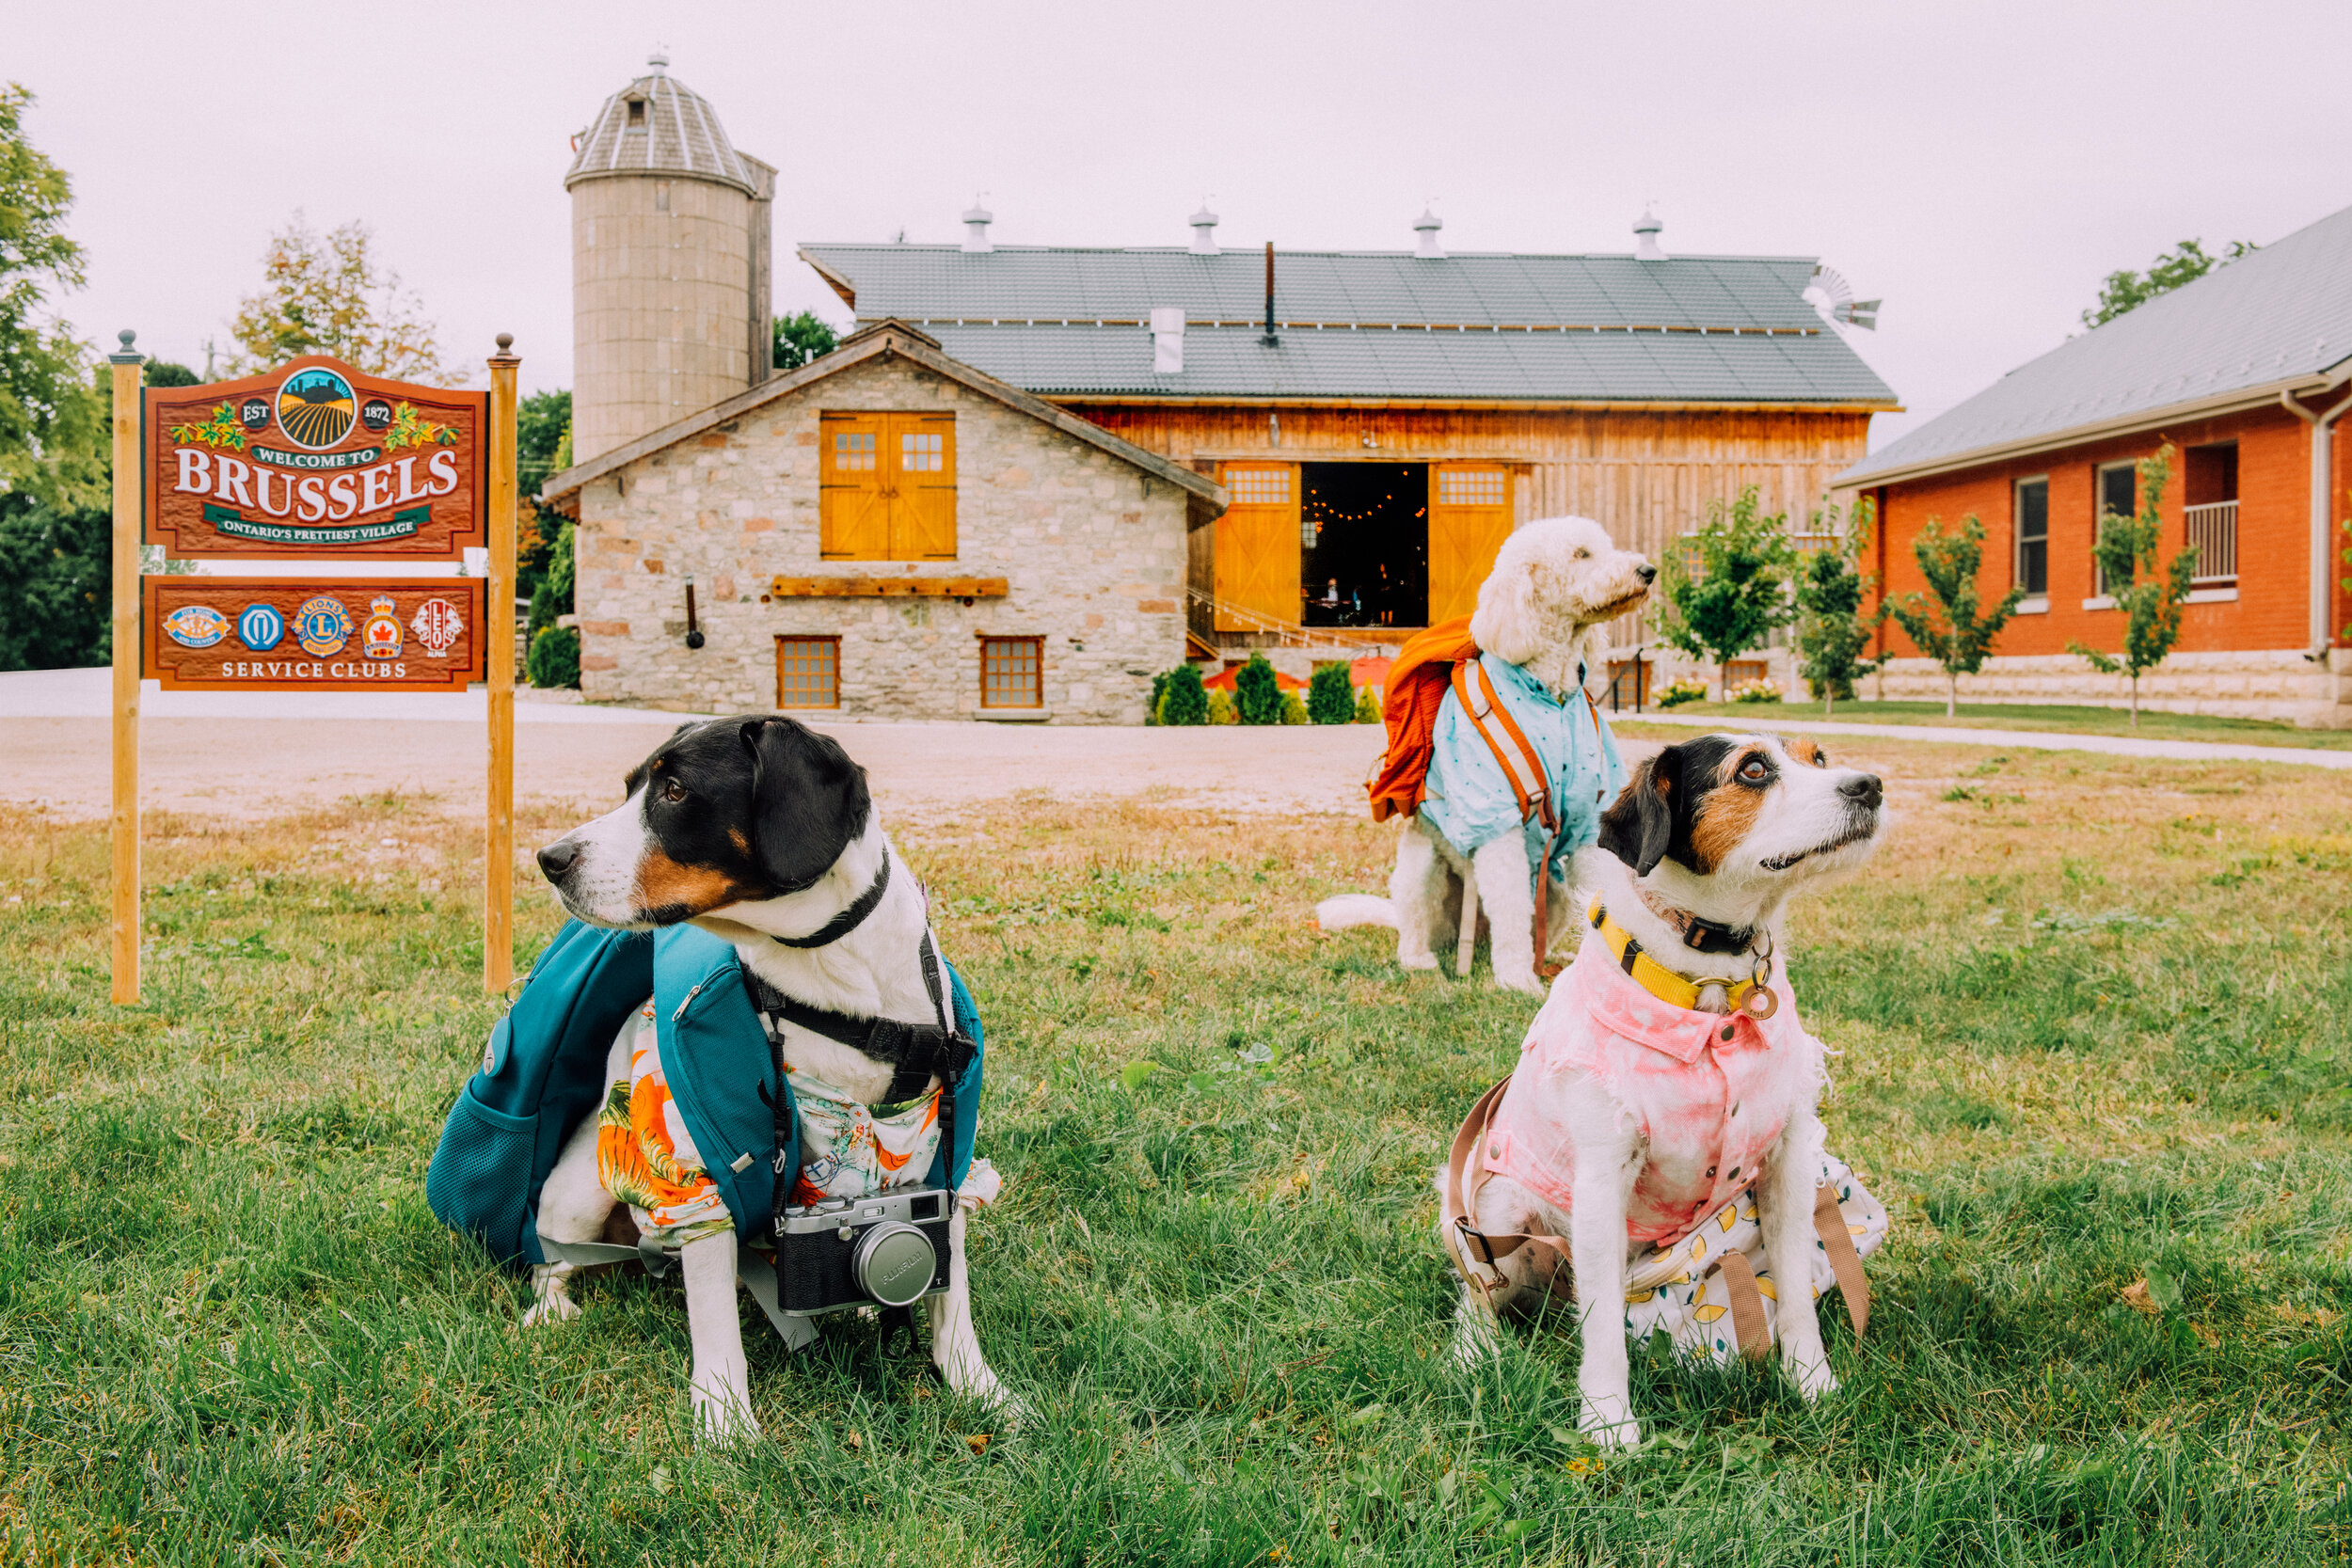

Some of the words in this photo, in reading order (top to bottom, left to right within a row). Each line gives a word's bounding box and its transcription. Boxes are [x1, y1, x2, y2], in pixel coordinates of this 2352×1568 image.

[243, 405, 269, 422] EST
[364, 406, 389, 422] 1872
[259, 448, 346, 467] WELCOME
[349, 450, 374, 465] TO
[173, 448, 458, 522] BRUSSELS
[224, 520, 292, 539] ONTARIO'S
[294, 530, 358, 540] PRETTIEST
[360, 522, 414, 537] VILLAGE
[305, 600, 341, 612] LIONS
[316, 615, 332, 637] L
[433, 603, 442, 645] LEO
[222, 662, 324, 677] SERVICE
[330, 662, 406, 677] CLUBS
[882, 1251, 922, 1285] FUJIFILM
